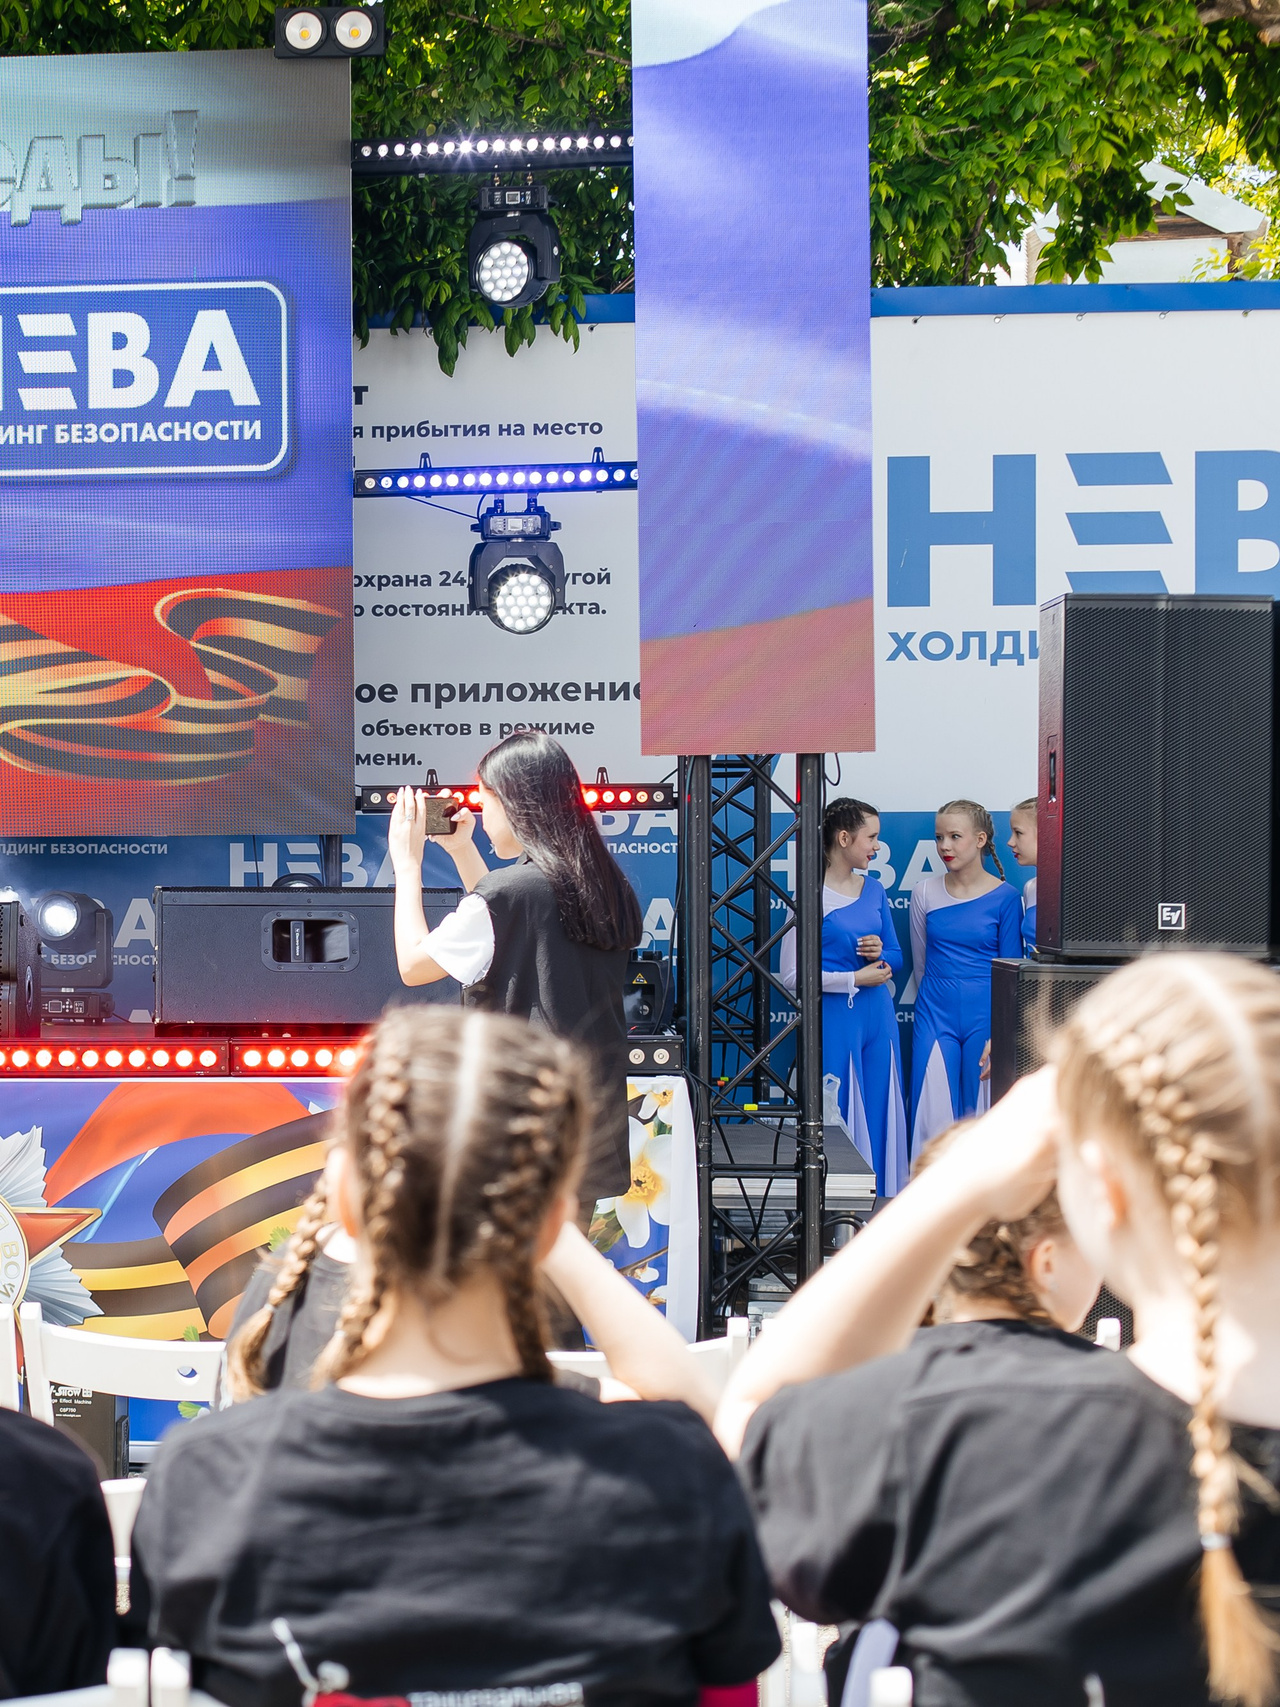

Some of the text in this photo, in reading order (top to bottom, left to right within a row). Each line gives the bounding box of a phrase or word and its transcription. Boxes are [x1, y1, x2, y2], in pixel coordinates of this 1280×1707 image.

[54, 420, 262, 445] БЕЗОПАСНОСТИ
[371, 420, 490, 442] прибытия
[498, 423, 525, 437] на
[533, 421, 603, 436] место
[354, 573, 432, 591] охрана
[361, 719, 595, 739] объектов в режиме
[51, 843, 168, 855] БЕЗОПАСНОСТИ
